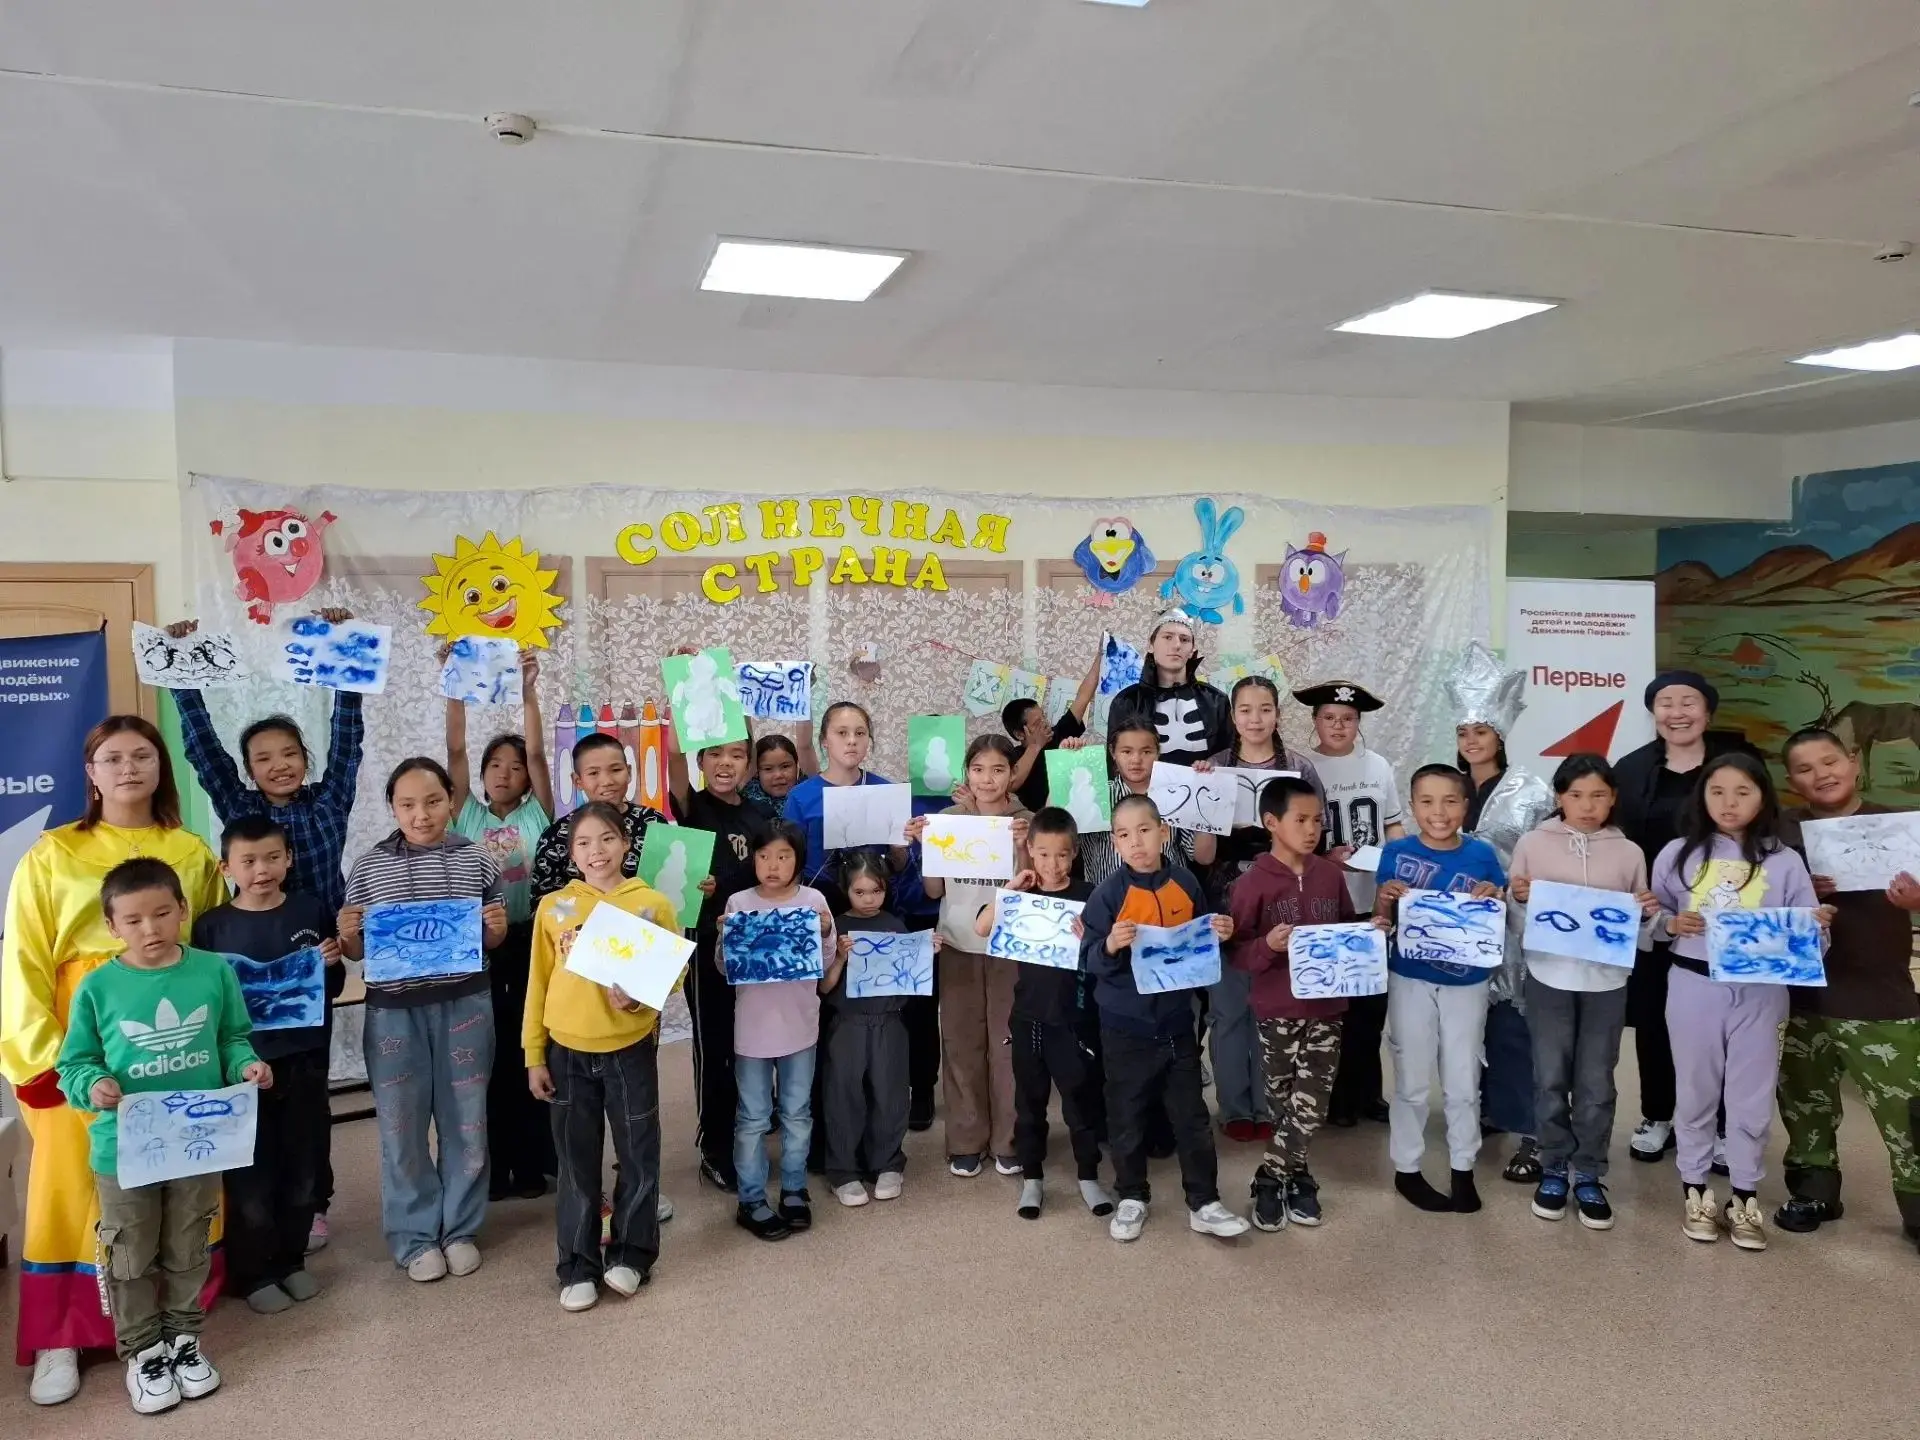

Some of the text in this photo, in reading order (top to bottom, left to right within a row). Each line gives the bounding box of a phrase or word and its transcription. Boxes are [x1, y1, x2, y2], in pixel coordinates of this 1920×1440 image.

[615, 496, 1012, 565] СОЛНЕЧНАЯ
[701, 545, 950, 604] СТРАНА
[1520, 608, 1636, 619] Российское движение
[1531, 618, 1563, 626] детей
[1533, 665, 1626, 692] Первые
[127, 1049, 210, 1080] adidas
